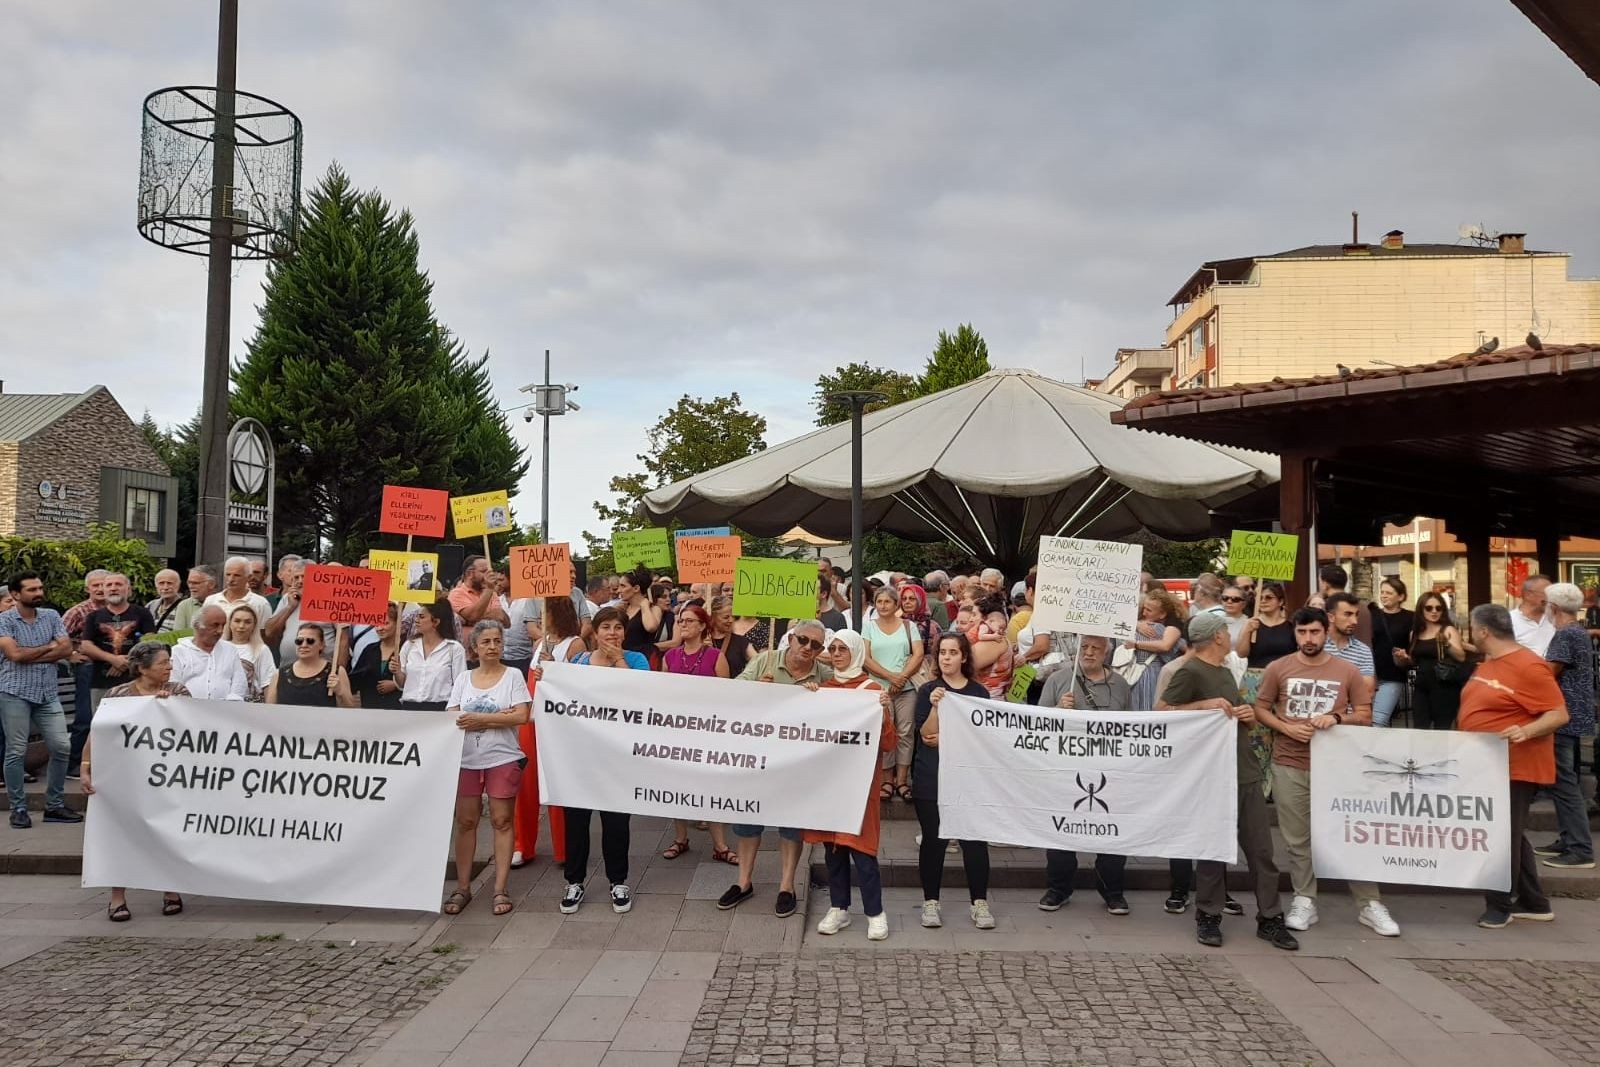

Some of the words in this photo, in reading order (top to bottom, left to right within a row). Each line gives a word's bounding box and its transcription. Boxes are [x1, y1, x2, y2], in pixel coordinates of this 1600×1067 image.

[1049, 537, 1084, 550] FINDIKLI
[1245, 533, 1279, 546] CAN
[517, 547, 564, 563] TALANA
[313, 570, 372, 587] ÜSTÜNDE
[530, 579, 557, 596] YOK!
[1040, 584, 1071, 595] ORMAN
[333, 587, 376, 600] HAYAT!
[307, 599, 355, 612] ALTINDA
[1065, 610, 1084, 622] DUR
[544, 700, 618, 721] DOĞAMIZ
[622, 709, 643, 724] VE
[647, 707, 727, 733] İRADEMİZ
[730, 721, 774, 738] GASP
[778, 723, 860, 745] EDİLEMEZ
[864, 731, 871, 746] !
[971, 709, 1065, 733] ORMANLARIN
[120, 723, 218, 757] YAŞAM
[224, 731, 422, 766] ALANLARIMIZA
[1014, 731, 1050, 754] AĞAÇ
[1129, 742, 1151, 757] DUR
[632, 742, 703, 763] MADENE
[706, 750, 757, 769] HAYIR
[760, 756, 767, 770] !
[241, 768, 388, 801] ÇIKIYORUZ
[634, 787, 704, 808] FINDIKLI
[710, 796, 760, 813] HALKI
[1390, 791, 1494, 822] MADEN
[182, 813, 275, 838] FINDIKLI
[281, 819, 343, 842] HALKI
[1052, 815, 1119, 837] Vaminon
[1344, 815, 1489, 852] İSTEMİYOR
